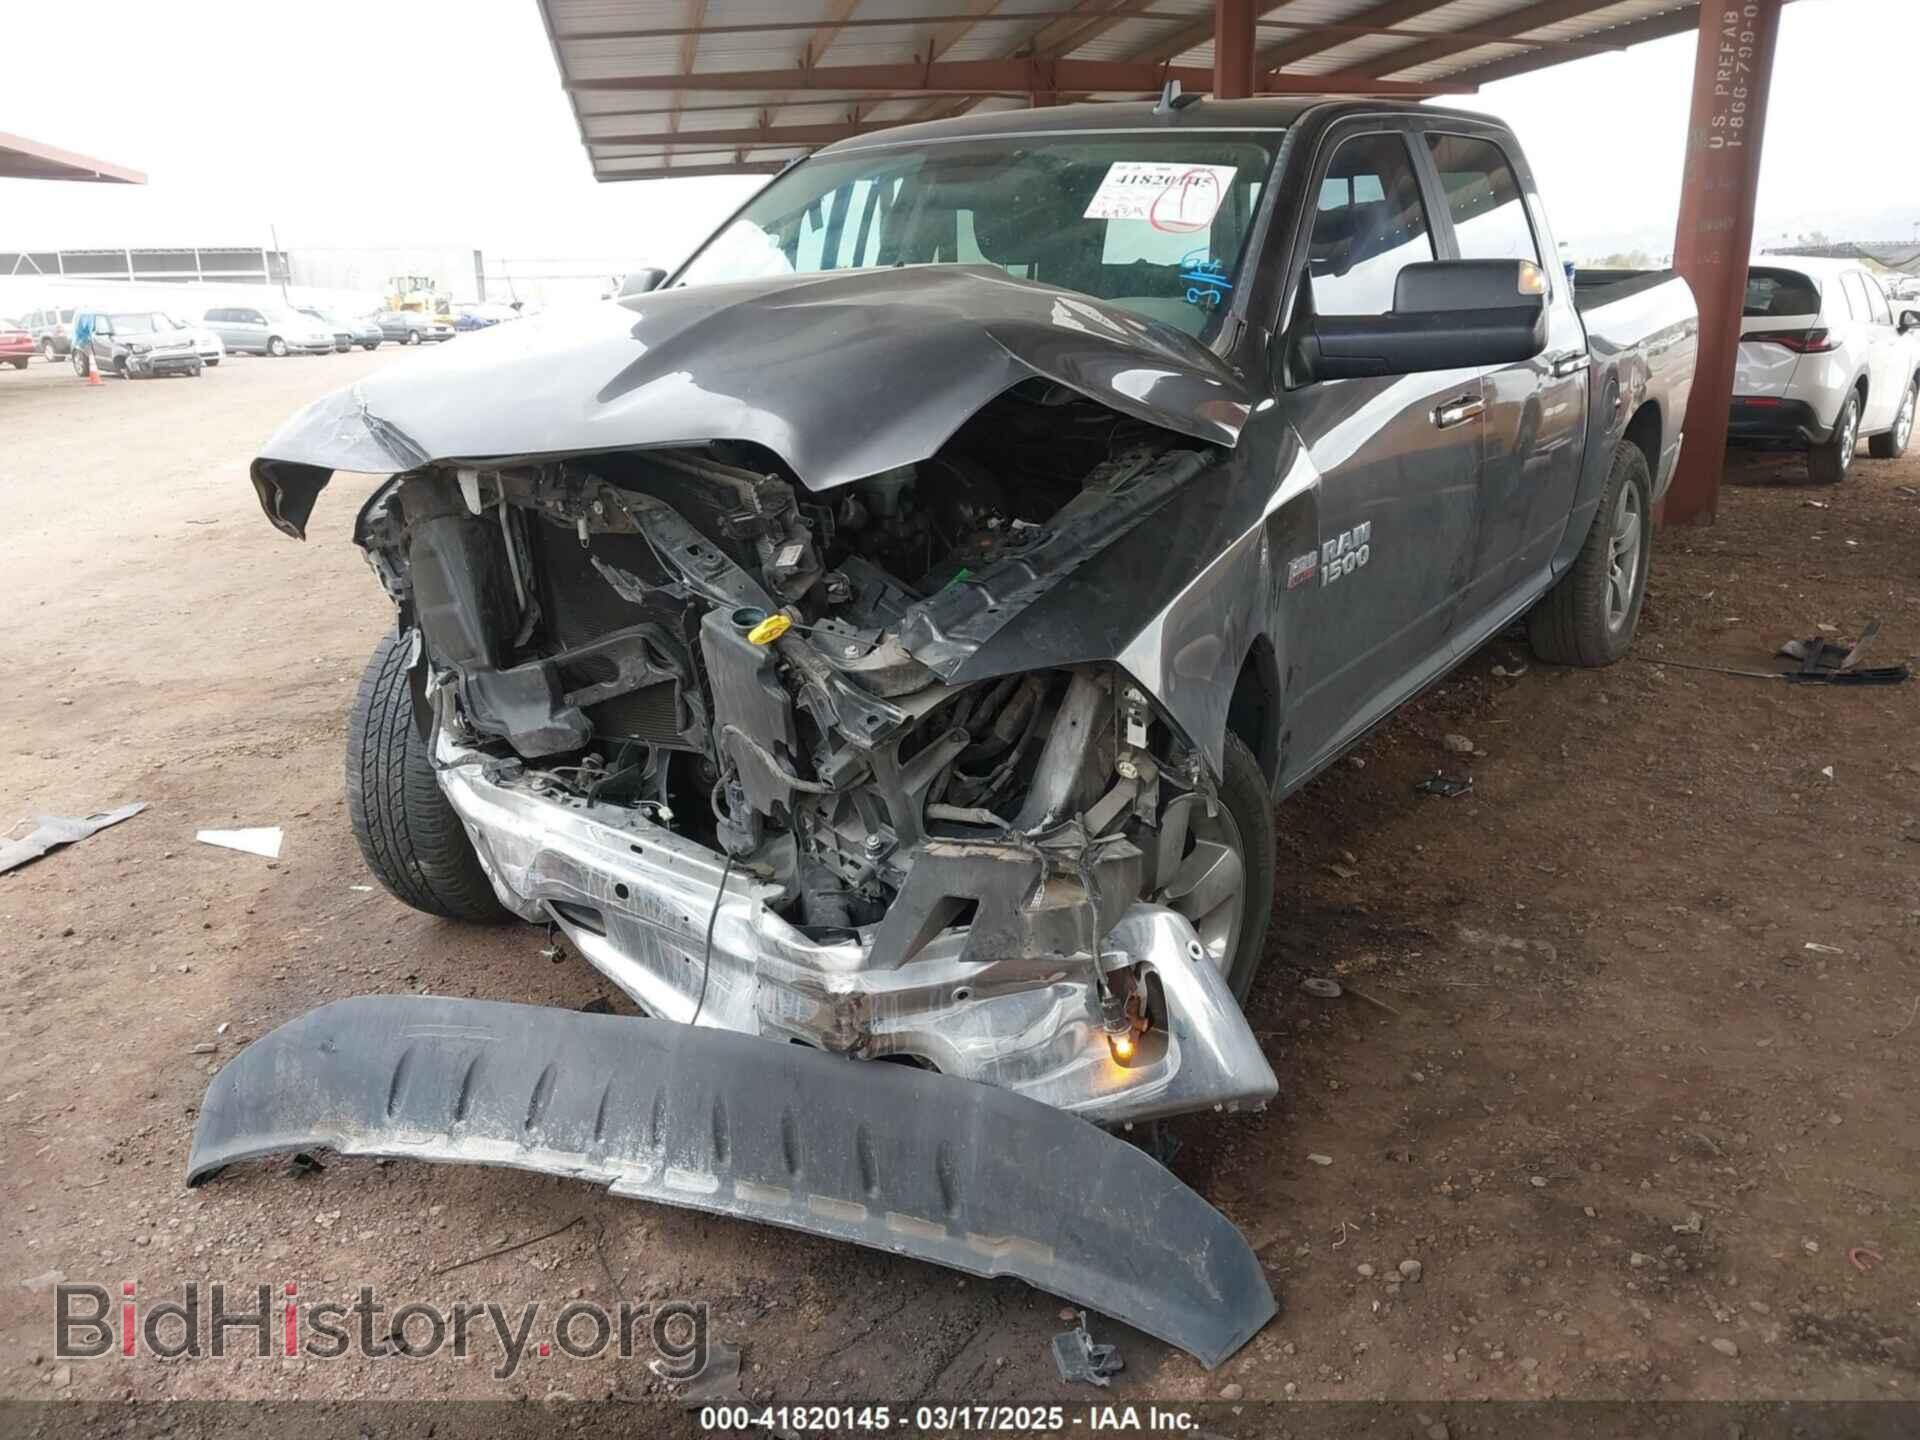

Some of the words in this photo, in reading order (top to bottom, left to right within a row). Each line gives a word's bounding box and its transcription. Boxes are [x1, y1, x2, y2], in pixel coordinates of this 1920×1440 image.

[1713, 10, 1739, 96] PREFAB
[1726, 0, 1761, 146] 1-866-799-0
[1708, 106, 1729, 149] U.S.
[1321, 520, 1371, 563] RAM
[1321, 543, 1370, 587] 1500
